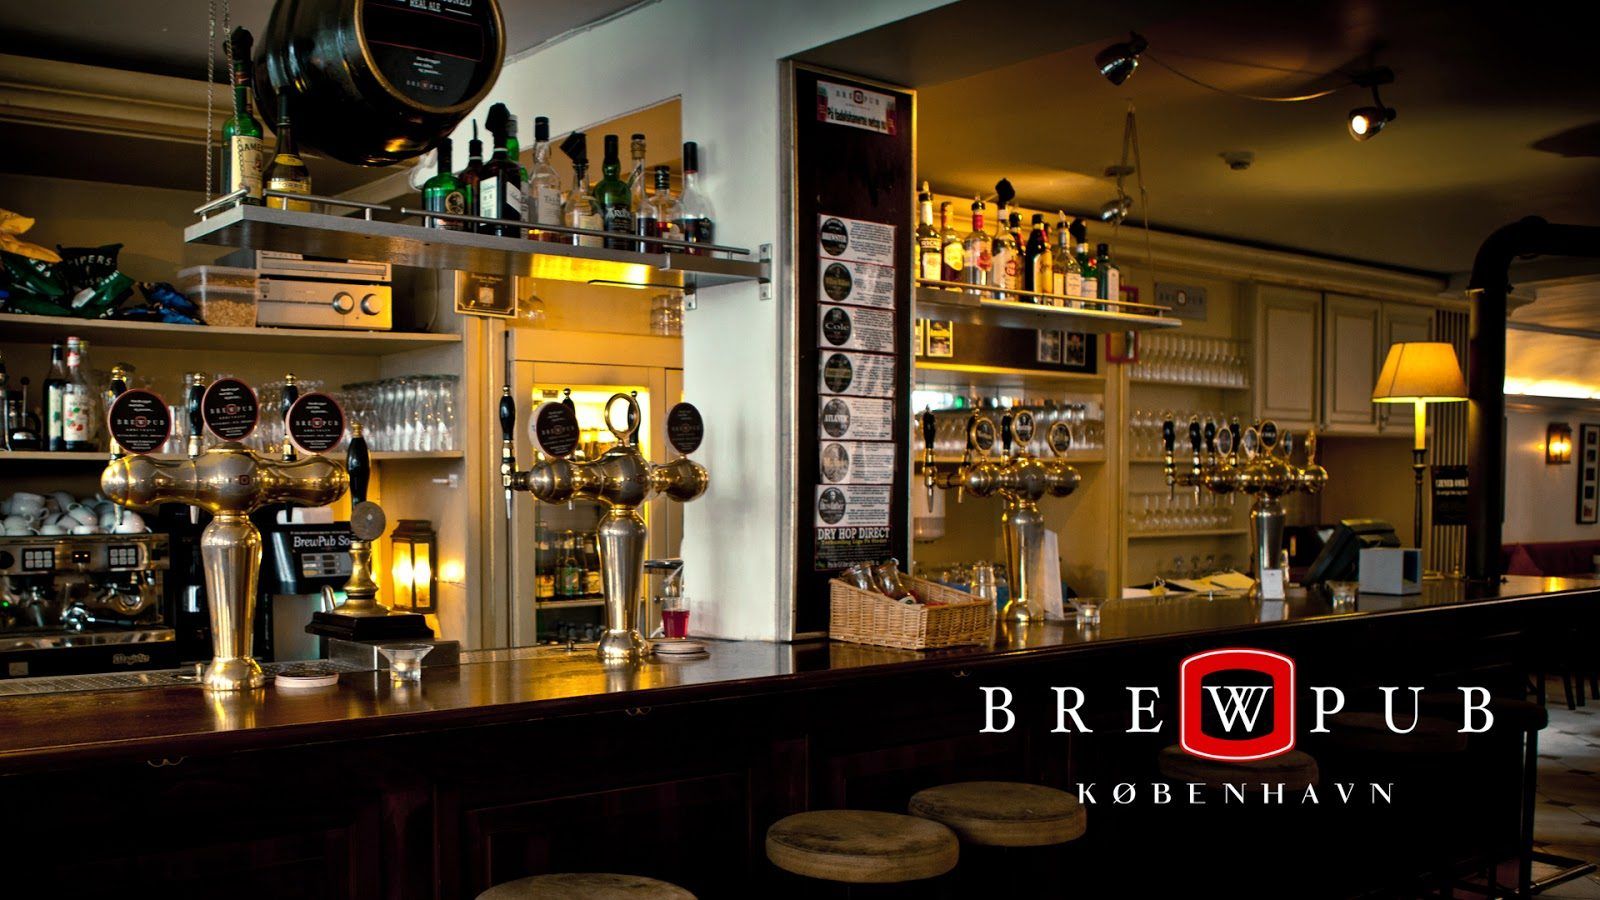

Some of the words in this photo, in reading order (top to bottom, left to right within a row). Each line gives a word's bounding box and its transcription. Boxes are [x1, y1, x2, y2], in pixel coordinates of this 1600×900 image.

[208, 403, 254, 417] BREWPUB
[116, 415, 166, 428] BREWPUB
[295, 417, 340, 429] BREWPUB
[817, 527, 836, 541] DRY
[838, 527, 857, 540] HOP
[858, 526, 890, 539] DIRECT
[293, 535, 336, 548] BrewPub
[337, 534, 351, 546] So
